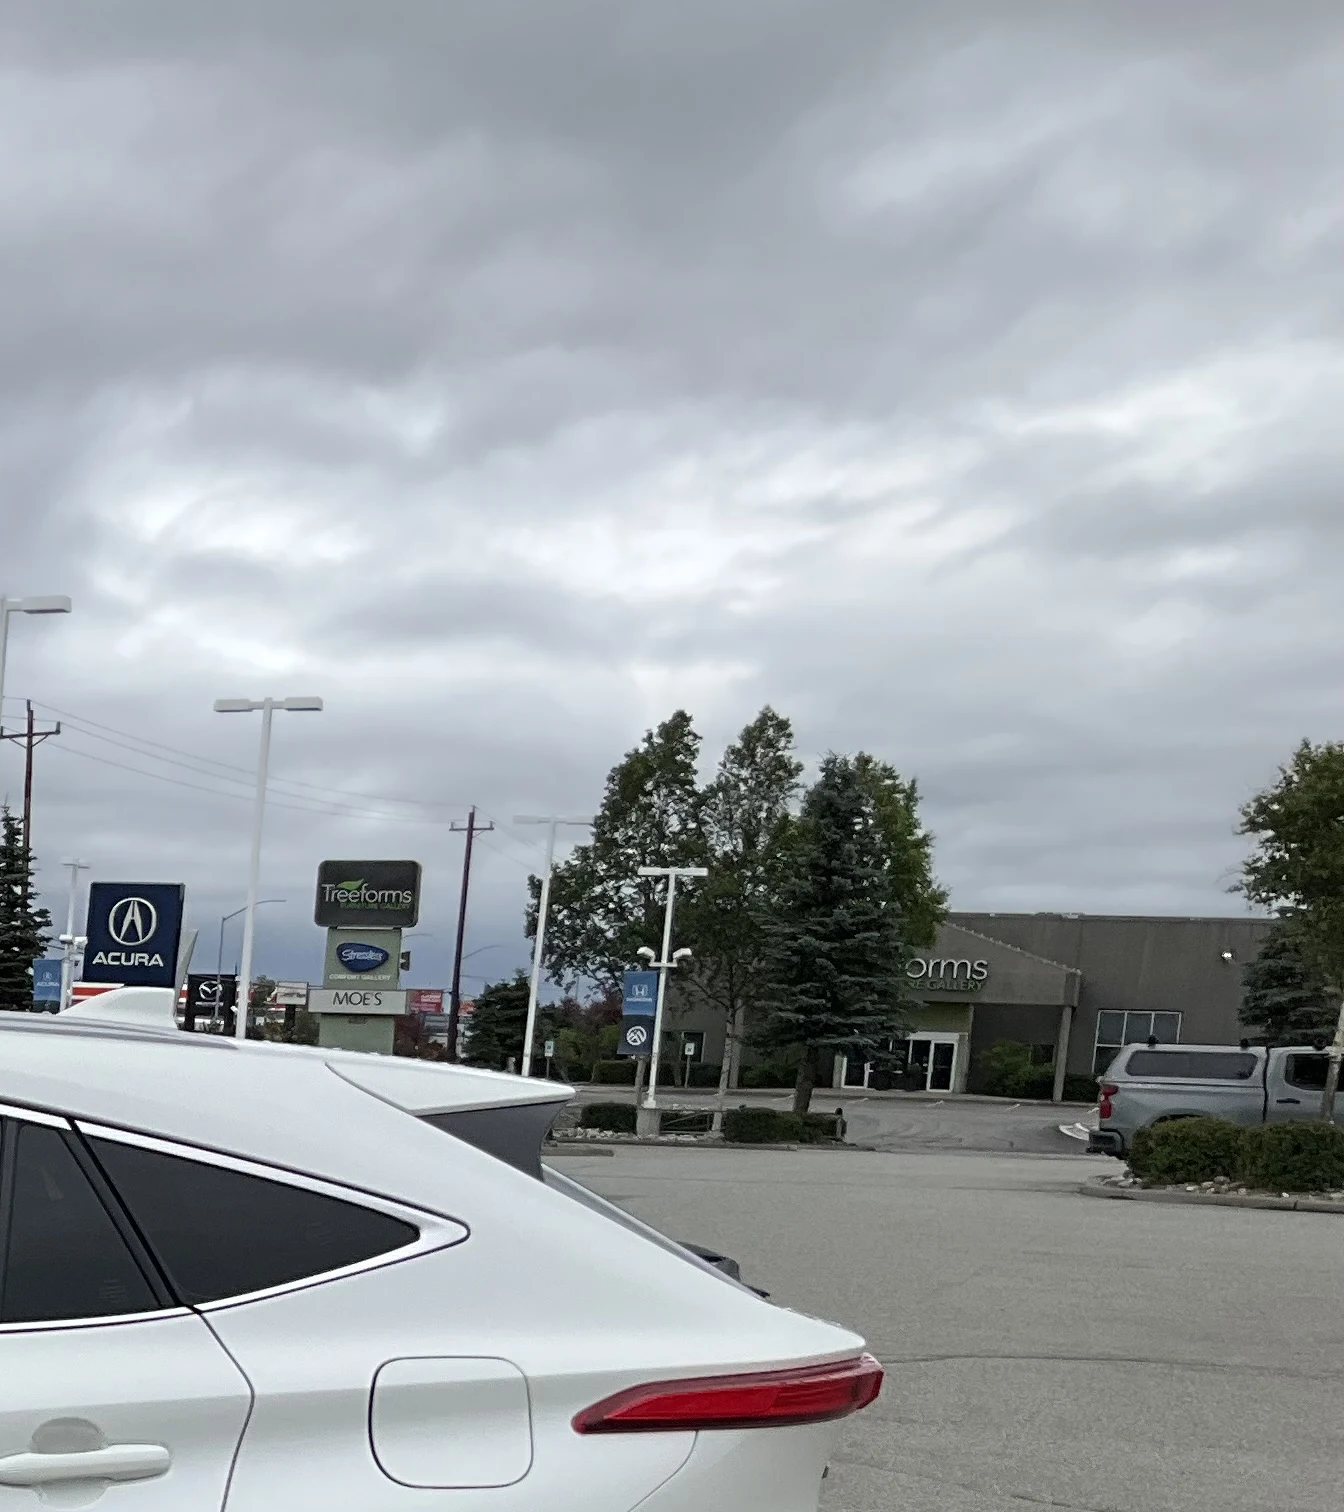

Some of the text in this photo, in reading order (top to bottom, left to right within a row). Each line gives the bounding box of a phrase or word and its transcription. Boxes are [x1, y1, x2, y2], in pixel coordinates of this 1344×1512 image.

[321, 882, 413, 903] Treeforms
[92, 951, 164, 967] ACURA
[905, 957, 989, 980] orms
[928, 980, 985, 992] GALLERY
